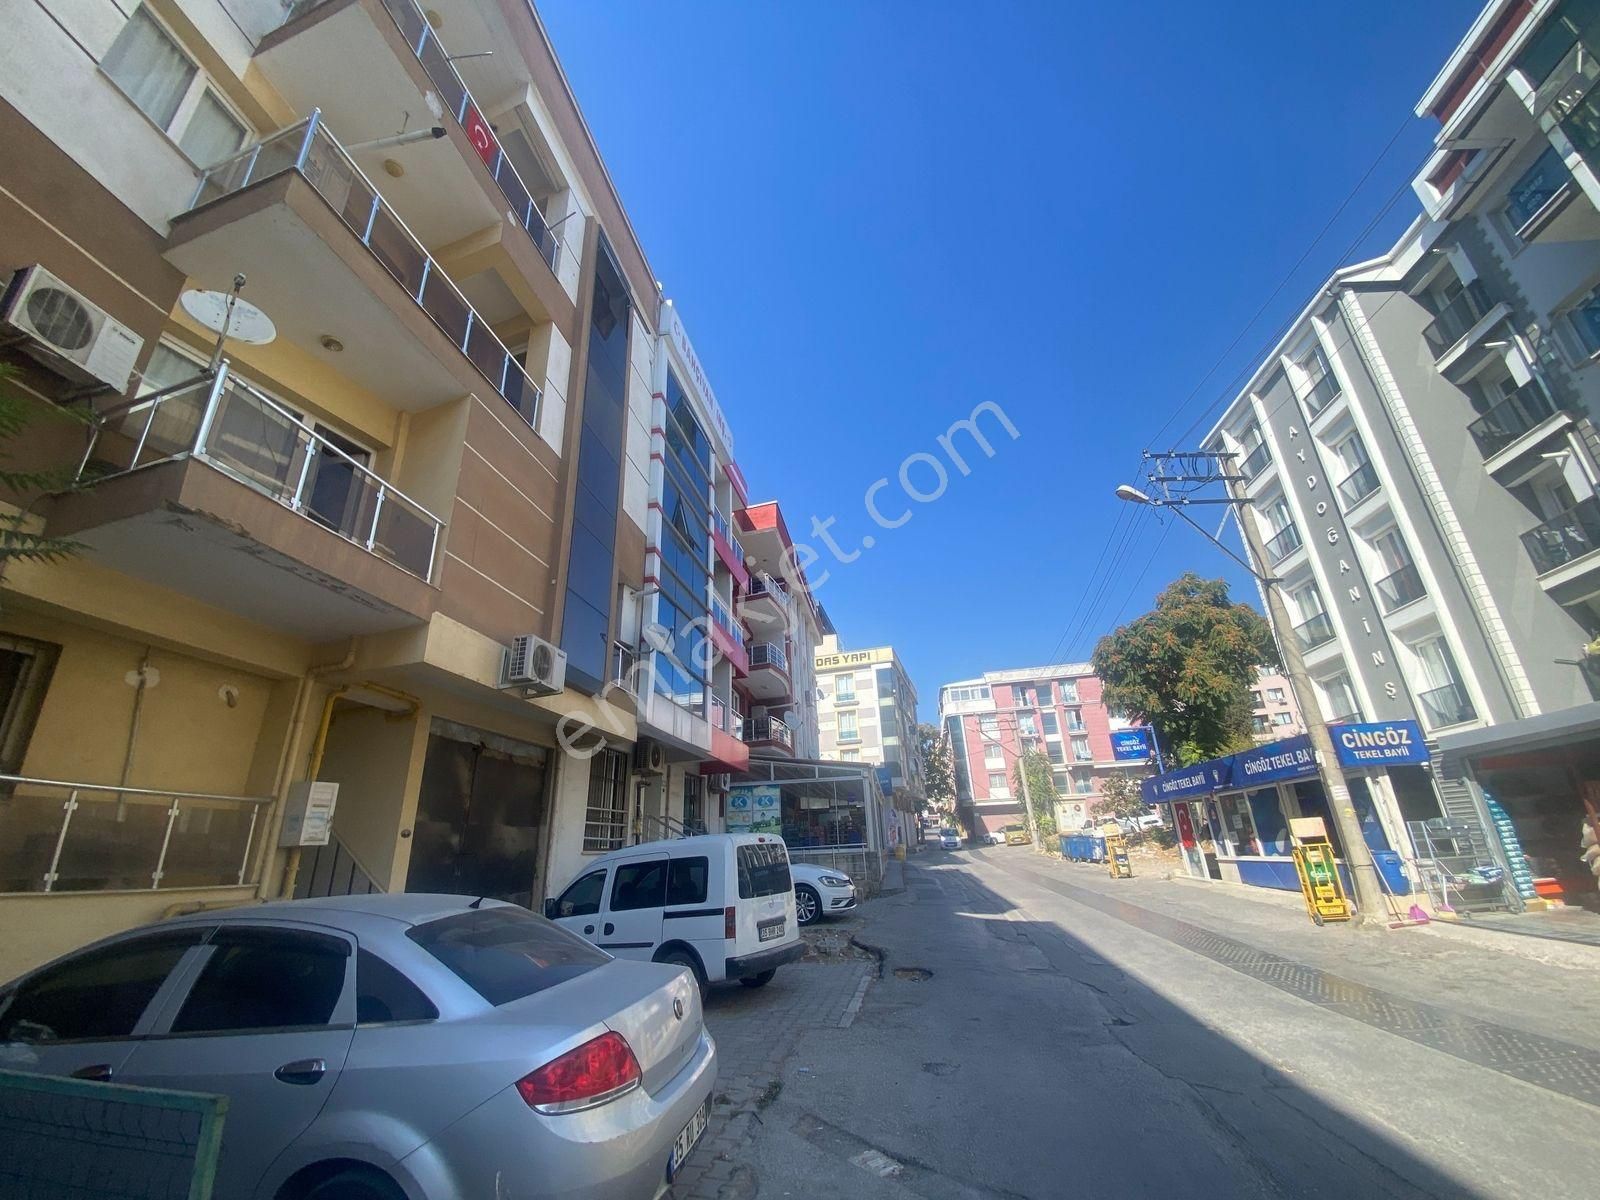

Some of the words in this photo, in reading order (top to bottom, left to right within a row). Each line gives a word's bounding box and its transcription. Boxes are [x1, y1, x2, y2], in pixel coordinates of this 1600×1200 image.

[842, 651, 871, 663] YAPI
[1341, 726, 1412, 748] CİNGÖZ
[1244, 756, 1272, 776] CİNGÖZ
[1272, 752, 1298, 769] TEKEL
[1296, 747, 1314, 764] BAY
[1353, 748, 1385, 760] TEKEL
[1177, 776, 1193, 790] TEKEL
[674, 1135, 684, 1165] 35
